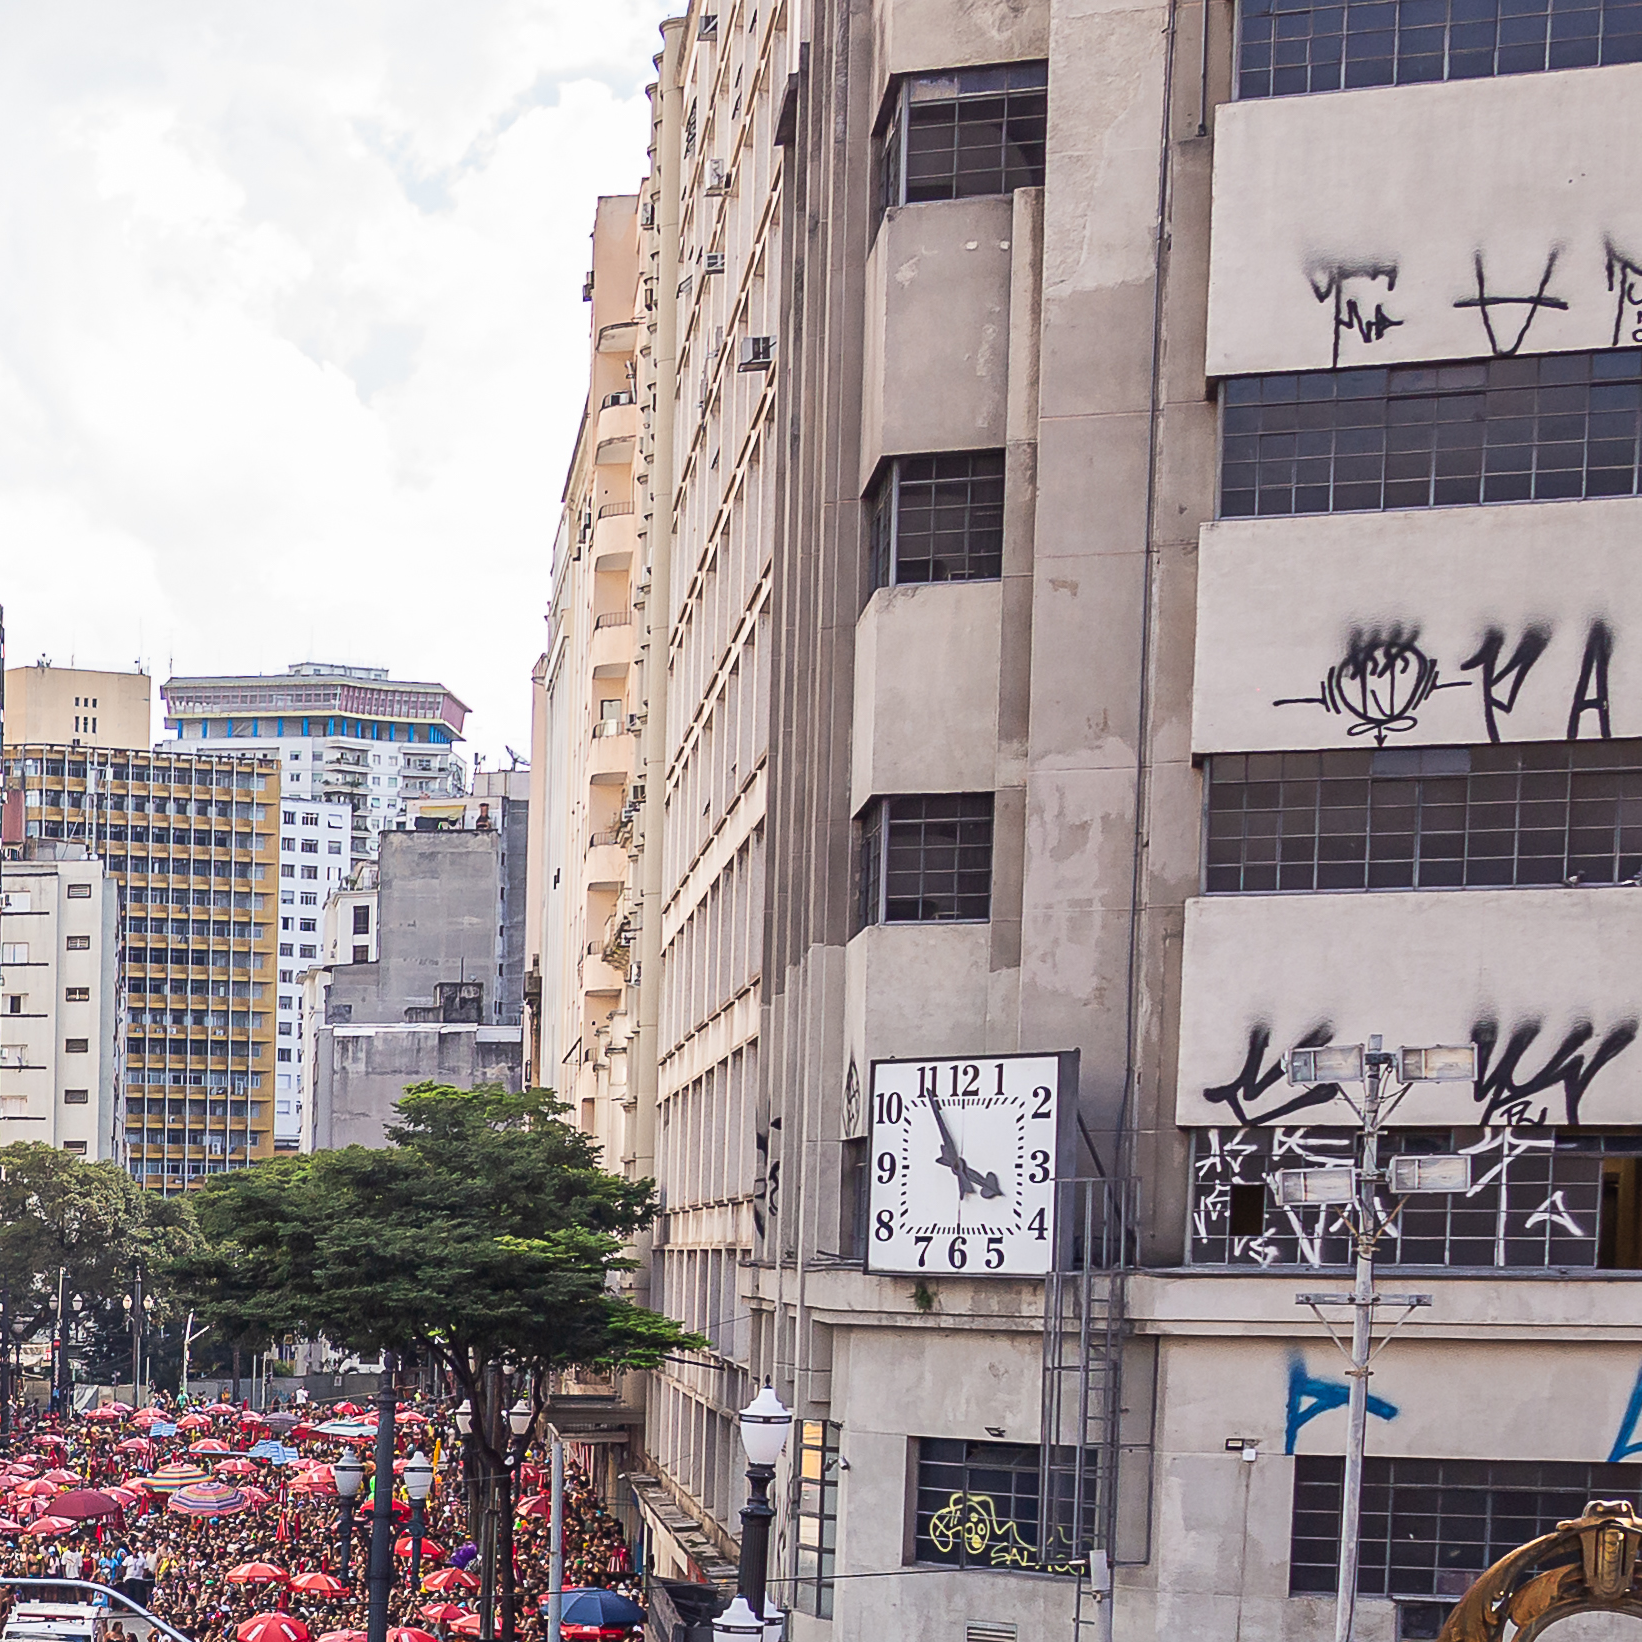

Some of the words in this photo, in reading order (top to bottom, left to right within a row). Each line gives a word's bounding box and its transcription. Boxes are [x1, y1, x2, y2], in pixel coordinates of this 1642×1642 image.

[917, 1066, 938, 1098] 11
[949, 1065, 980, 1097] 12
[994, 1063, 1005, 1095] 1
[875, 1092, 903, 1124] 10
[1031, 1086, 1052, 1119] 2
[877, 1152, 897, 1184] 9
[1028, 1150, 1050, 1183] 3
[875, 1209, 894, 1241] 8
[1027, 1208, 1048, 1240] 4
[914, 1236, 933, 1267] 7
[948, 1236, 967, 1269] 6
[985, 1237, 1005, 1269] 5
